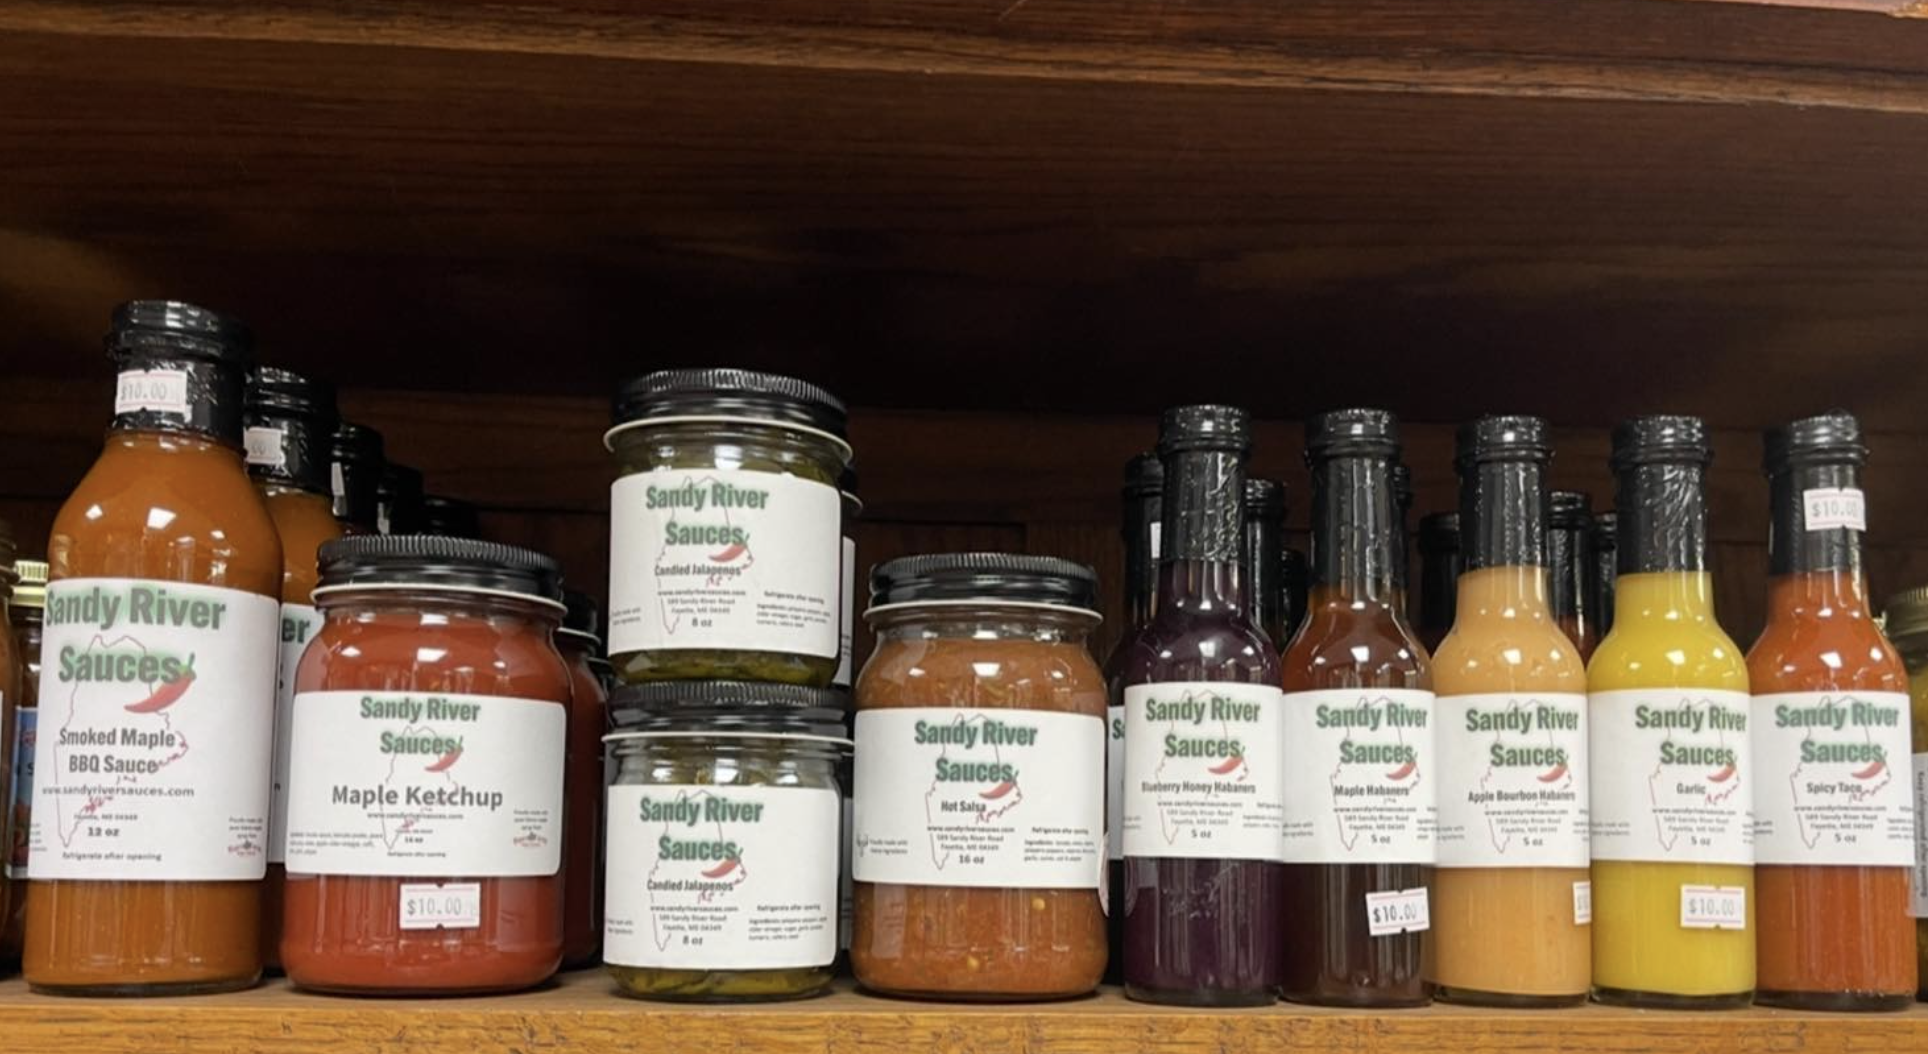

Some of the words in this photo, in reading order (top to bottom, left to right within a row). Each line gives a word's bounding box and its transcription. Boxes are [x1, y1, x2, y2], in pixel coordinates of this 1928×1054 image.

[646, 484, 706, 512] Sandy
[711, 483, 769, 509] River
[1811, 501, 1858, 517] $10.00
[665, 522, 743, 546] Sauces
[655, 564, 690, 576] Candied
[692, 564, 741, 577] Jalapenos
[46, 587, 121, 628] Sandy
[130, 588, 226, 629] River
[692, 617, 698, 627] 8
[700, 619, 712, 627] oz
[59, 645, 183, 683] Sauces
[360, 696, 422, 723] Sandy
[427, 698, 481, 722] River
[1145, 698, 1206, 724] Sandy
[1211, 698, 1260, 722] River
[1316, 705, 1382, 731] Sandy
[1386, 703, 1427, 727] River
[1635, 705, 1704, 732] Sandy
[1708, 706, 1746, 731] River
[1775, 705, 1845, 731] Sandy
[1852, 703, 1899, 727] River
[1466, 708, 1532, 734] Sandy
[1537, 707, 1579, 731] River
[59, 728, 117, 746] Smoked
[121, 728, 175, 749] Maple
[380, 732, 455, 754] Sauces
[914, 720, 978, 749] Sandy
[982, 721, 1038, 745] River
[1164, 734, 1240, 758] Sauces
[1339, 740, 1413, 764] Sauces
[1490, 744, 1565, 768] Sauces
[1660, 741, 1734, 766] Sauces
[1801, 740, 1882, 763] Sauces
[69, 756, 100, 774] BBQ
[103, 755, 158, 774] Sauce
[936, 758, 1013, 782] Sauces
[42, 785, 194, 798] www.sandyriversauces.com
[332, 785, 398, 809] Maple
[406, 786, 503, 811] Ketchup
[1141, 782, 1180, 794] Blueberry
[1182, 782, 1212, 794] Honey
[1333, 785, 1365, 797] Maple
[1468, 791, 1494, 803] Apple
[1496, 790, 1537, 801] Bourbon
[1676, 783, 1706, 795] Garlic
[1807, 782, 1836, 794] Spicy
[1838, 782, 1862, 793] Taco
[640, 797, 699, 826] Sandy
[705, 797, 763, 822] River
[941, 801, 957, 813] Hot
[959, 801, 986, 813] Salsa
[88, 827, 101, 837] 12
[105, 829, 119, 837] oz
[1191, 830, 1197, 838] 5
[1371, 835, 1377, 843] 5
[1523, 838, 1529, 846] 5
[1691, 836, 1697, 845] 5
[1835, 834, 1841, 842] 5
[126, 853, 162, 862] opening
[658, 836, 736, 860] Sauces
[959, 855, 971, 864] 16
[973, 856, 985, 864] oz
[647, 879, 682, 891] Candied
[684, 879, 733, 892] Jalapenos
[407, 896, 462, 917] $10.00
[1373, 903, 1417, 924] $10.00
[1688, 898, 1735, 915] $10.00
[683, 935, 689, 945] 8
[691, 937, 703, 945] oz
